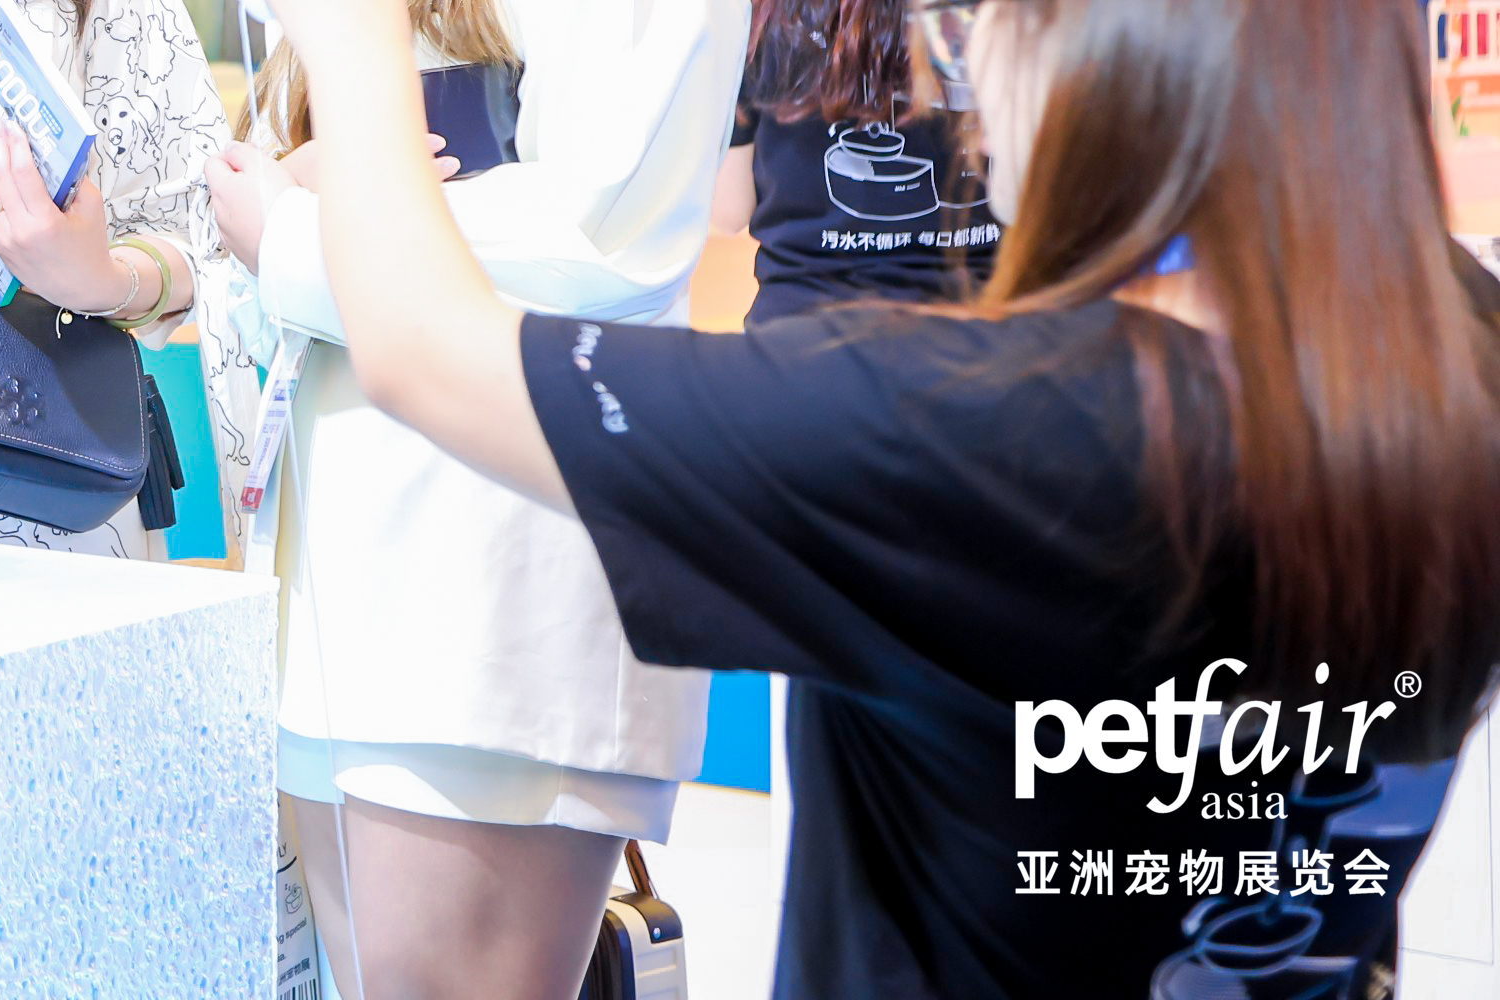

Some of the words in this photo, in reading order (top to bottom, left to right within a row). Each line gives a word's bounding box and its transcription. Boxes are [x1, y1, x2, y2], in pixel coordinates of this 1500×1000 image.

[821, 230, 912, 251] 污水不循环
